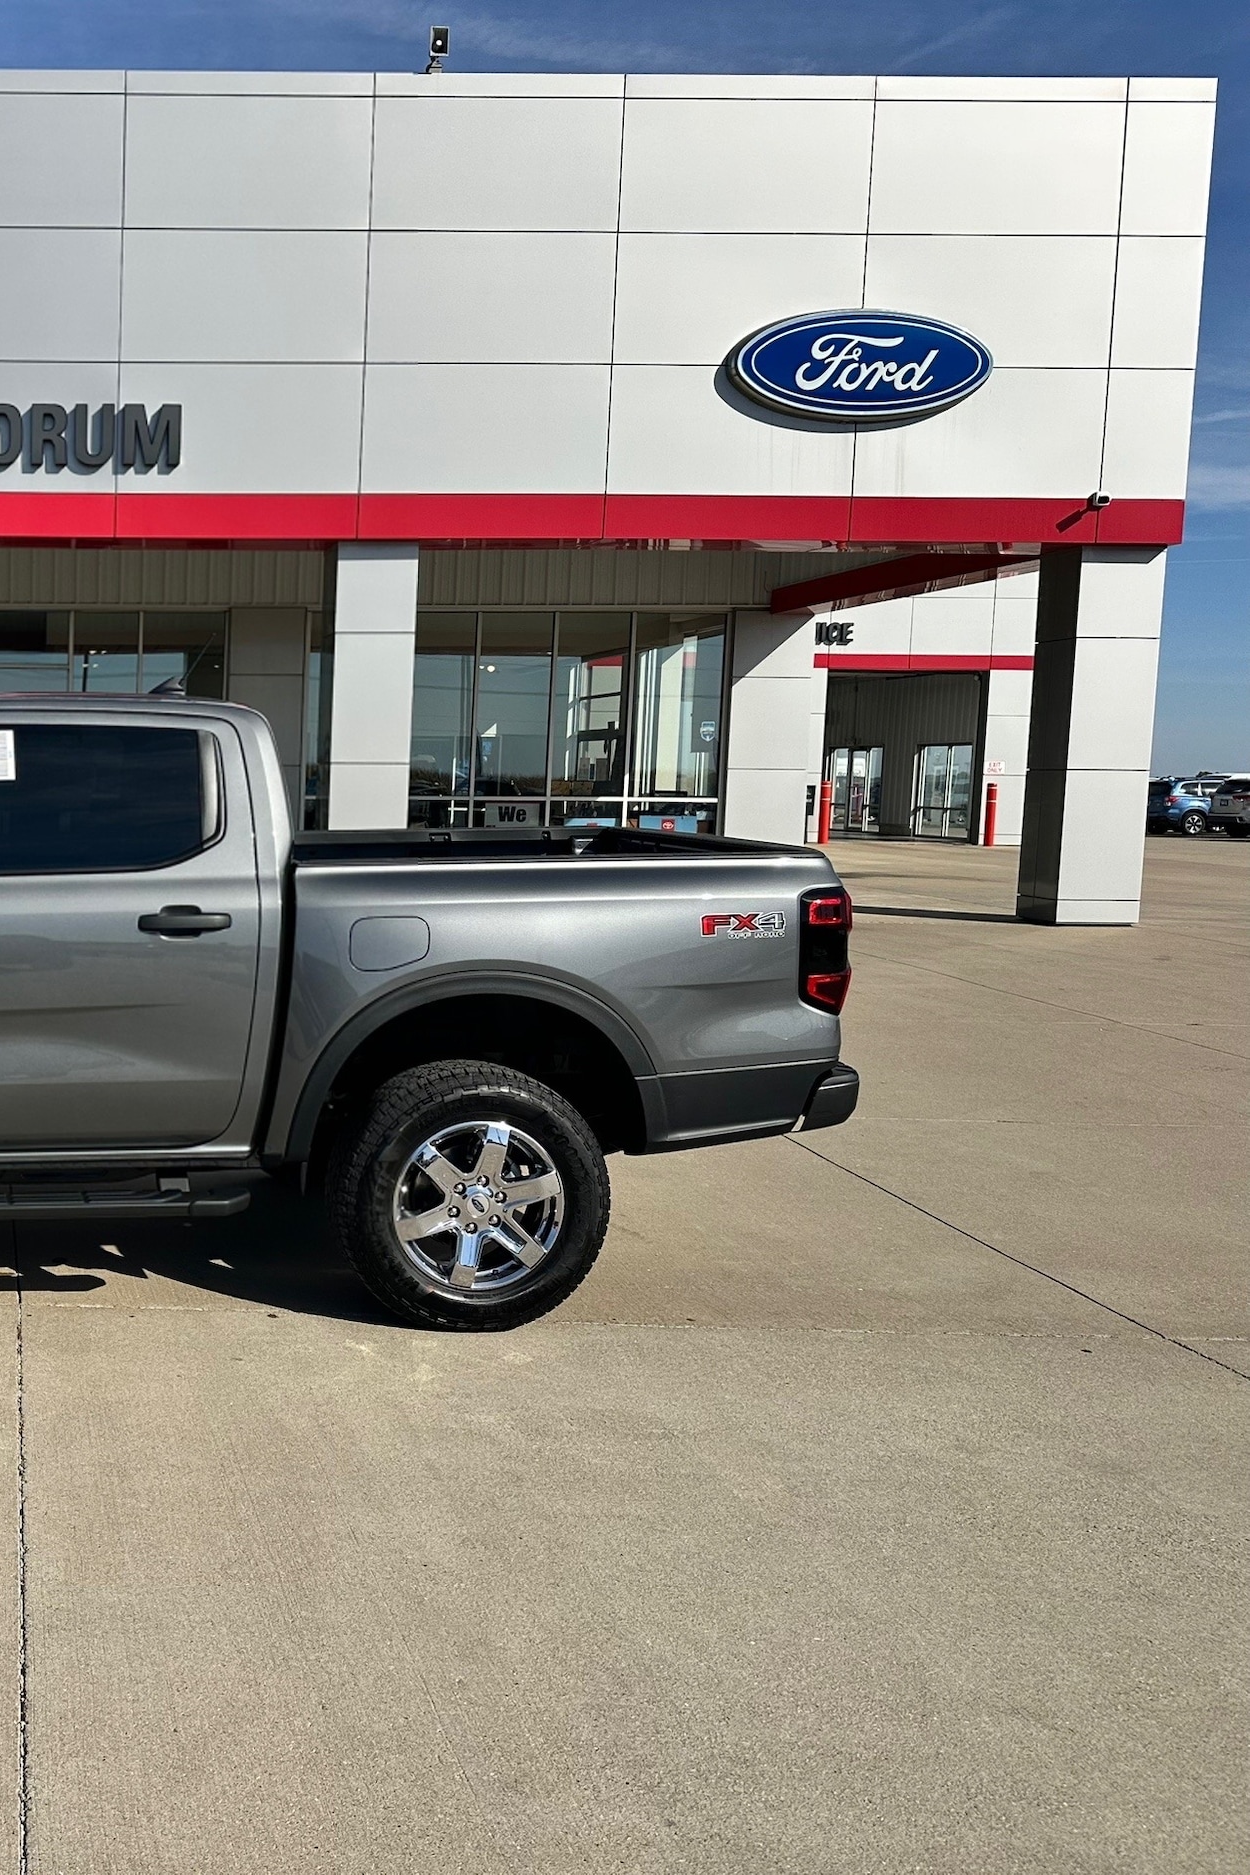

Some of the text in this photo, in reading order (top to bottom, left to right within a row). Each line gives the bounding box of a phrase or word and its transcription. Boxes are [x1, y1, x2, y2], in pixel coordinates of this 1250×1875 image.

[795, 333, 940, 391] Ford
[498, 806, 527, 823] We
[700, 909, 786, 937] FX4
